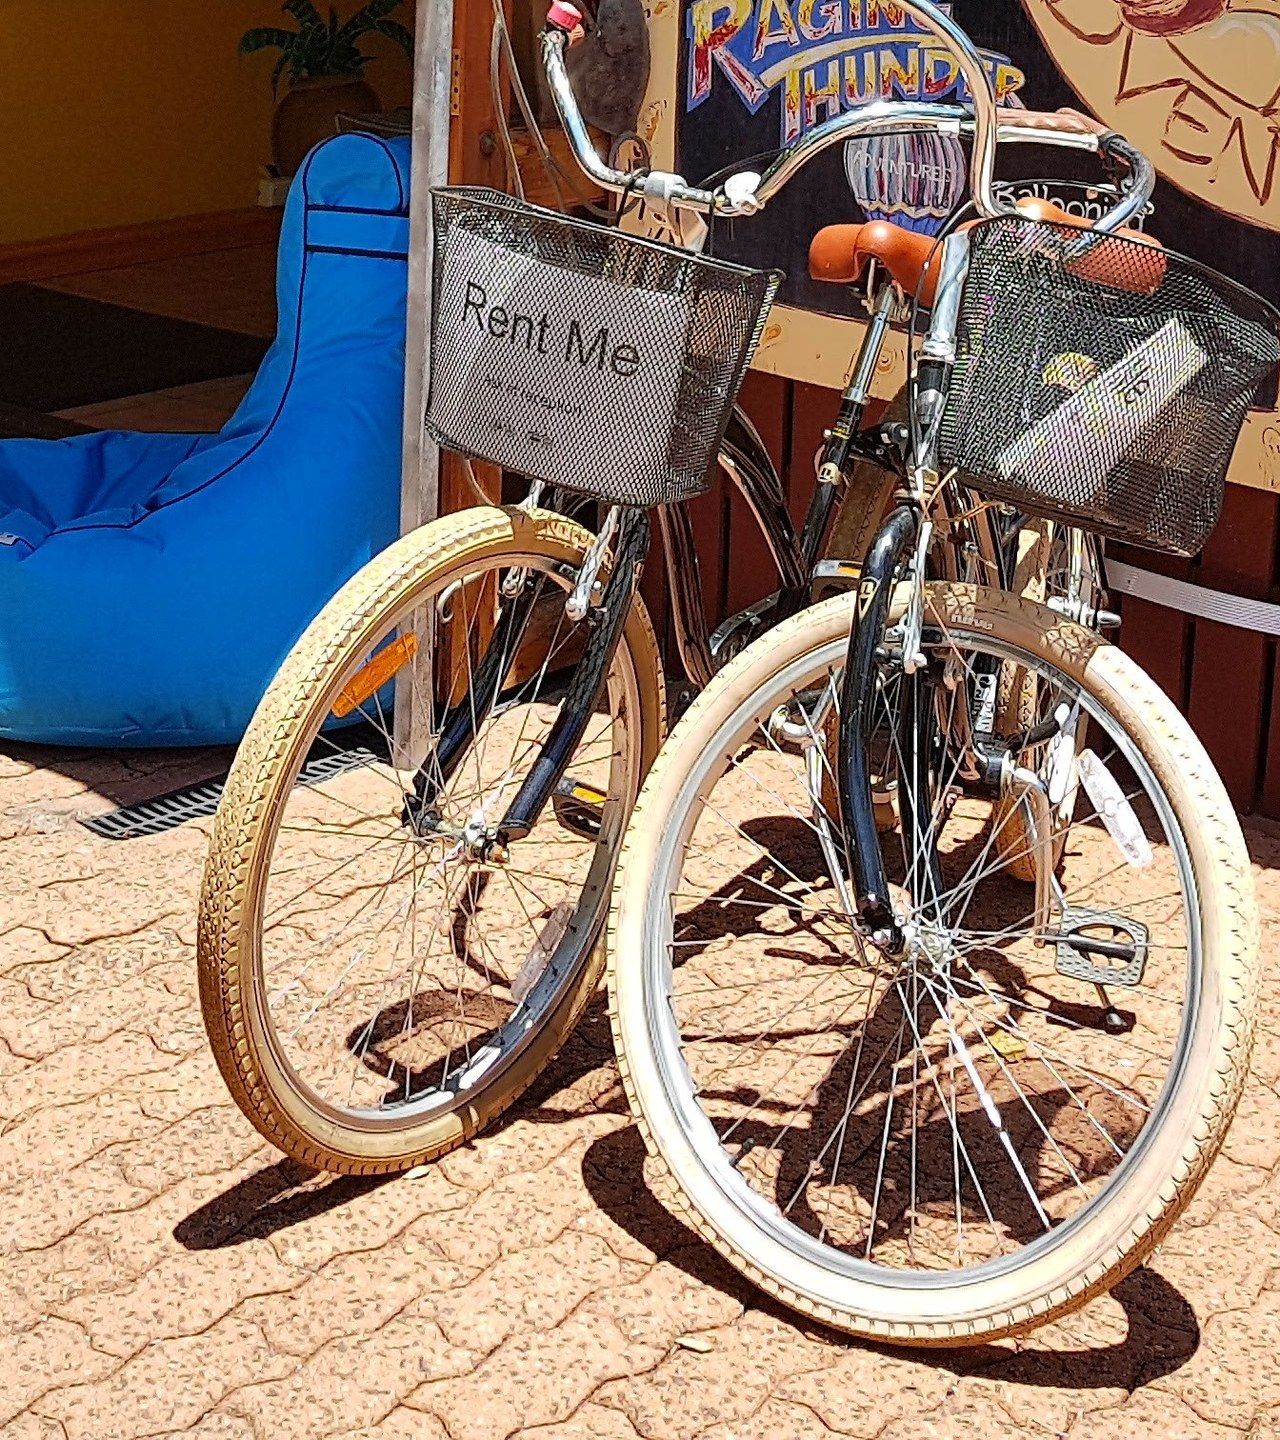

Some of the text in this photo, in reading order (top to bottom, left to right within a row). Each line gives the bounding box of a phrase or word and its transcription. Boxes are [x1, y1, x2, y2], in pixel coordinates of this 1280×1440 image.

[782, 48, 1026, 144] THUNDR
[463, 280, 642, 378] Rent Me
